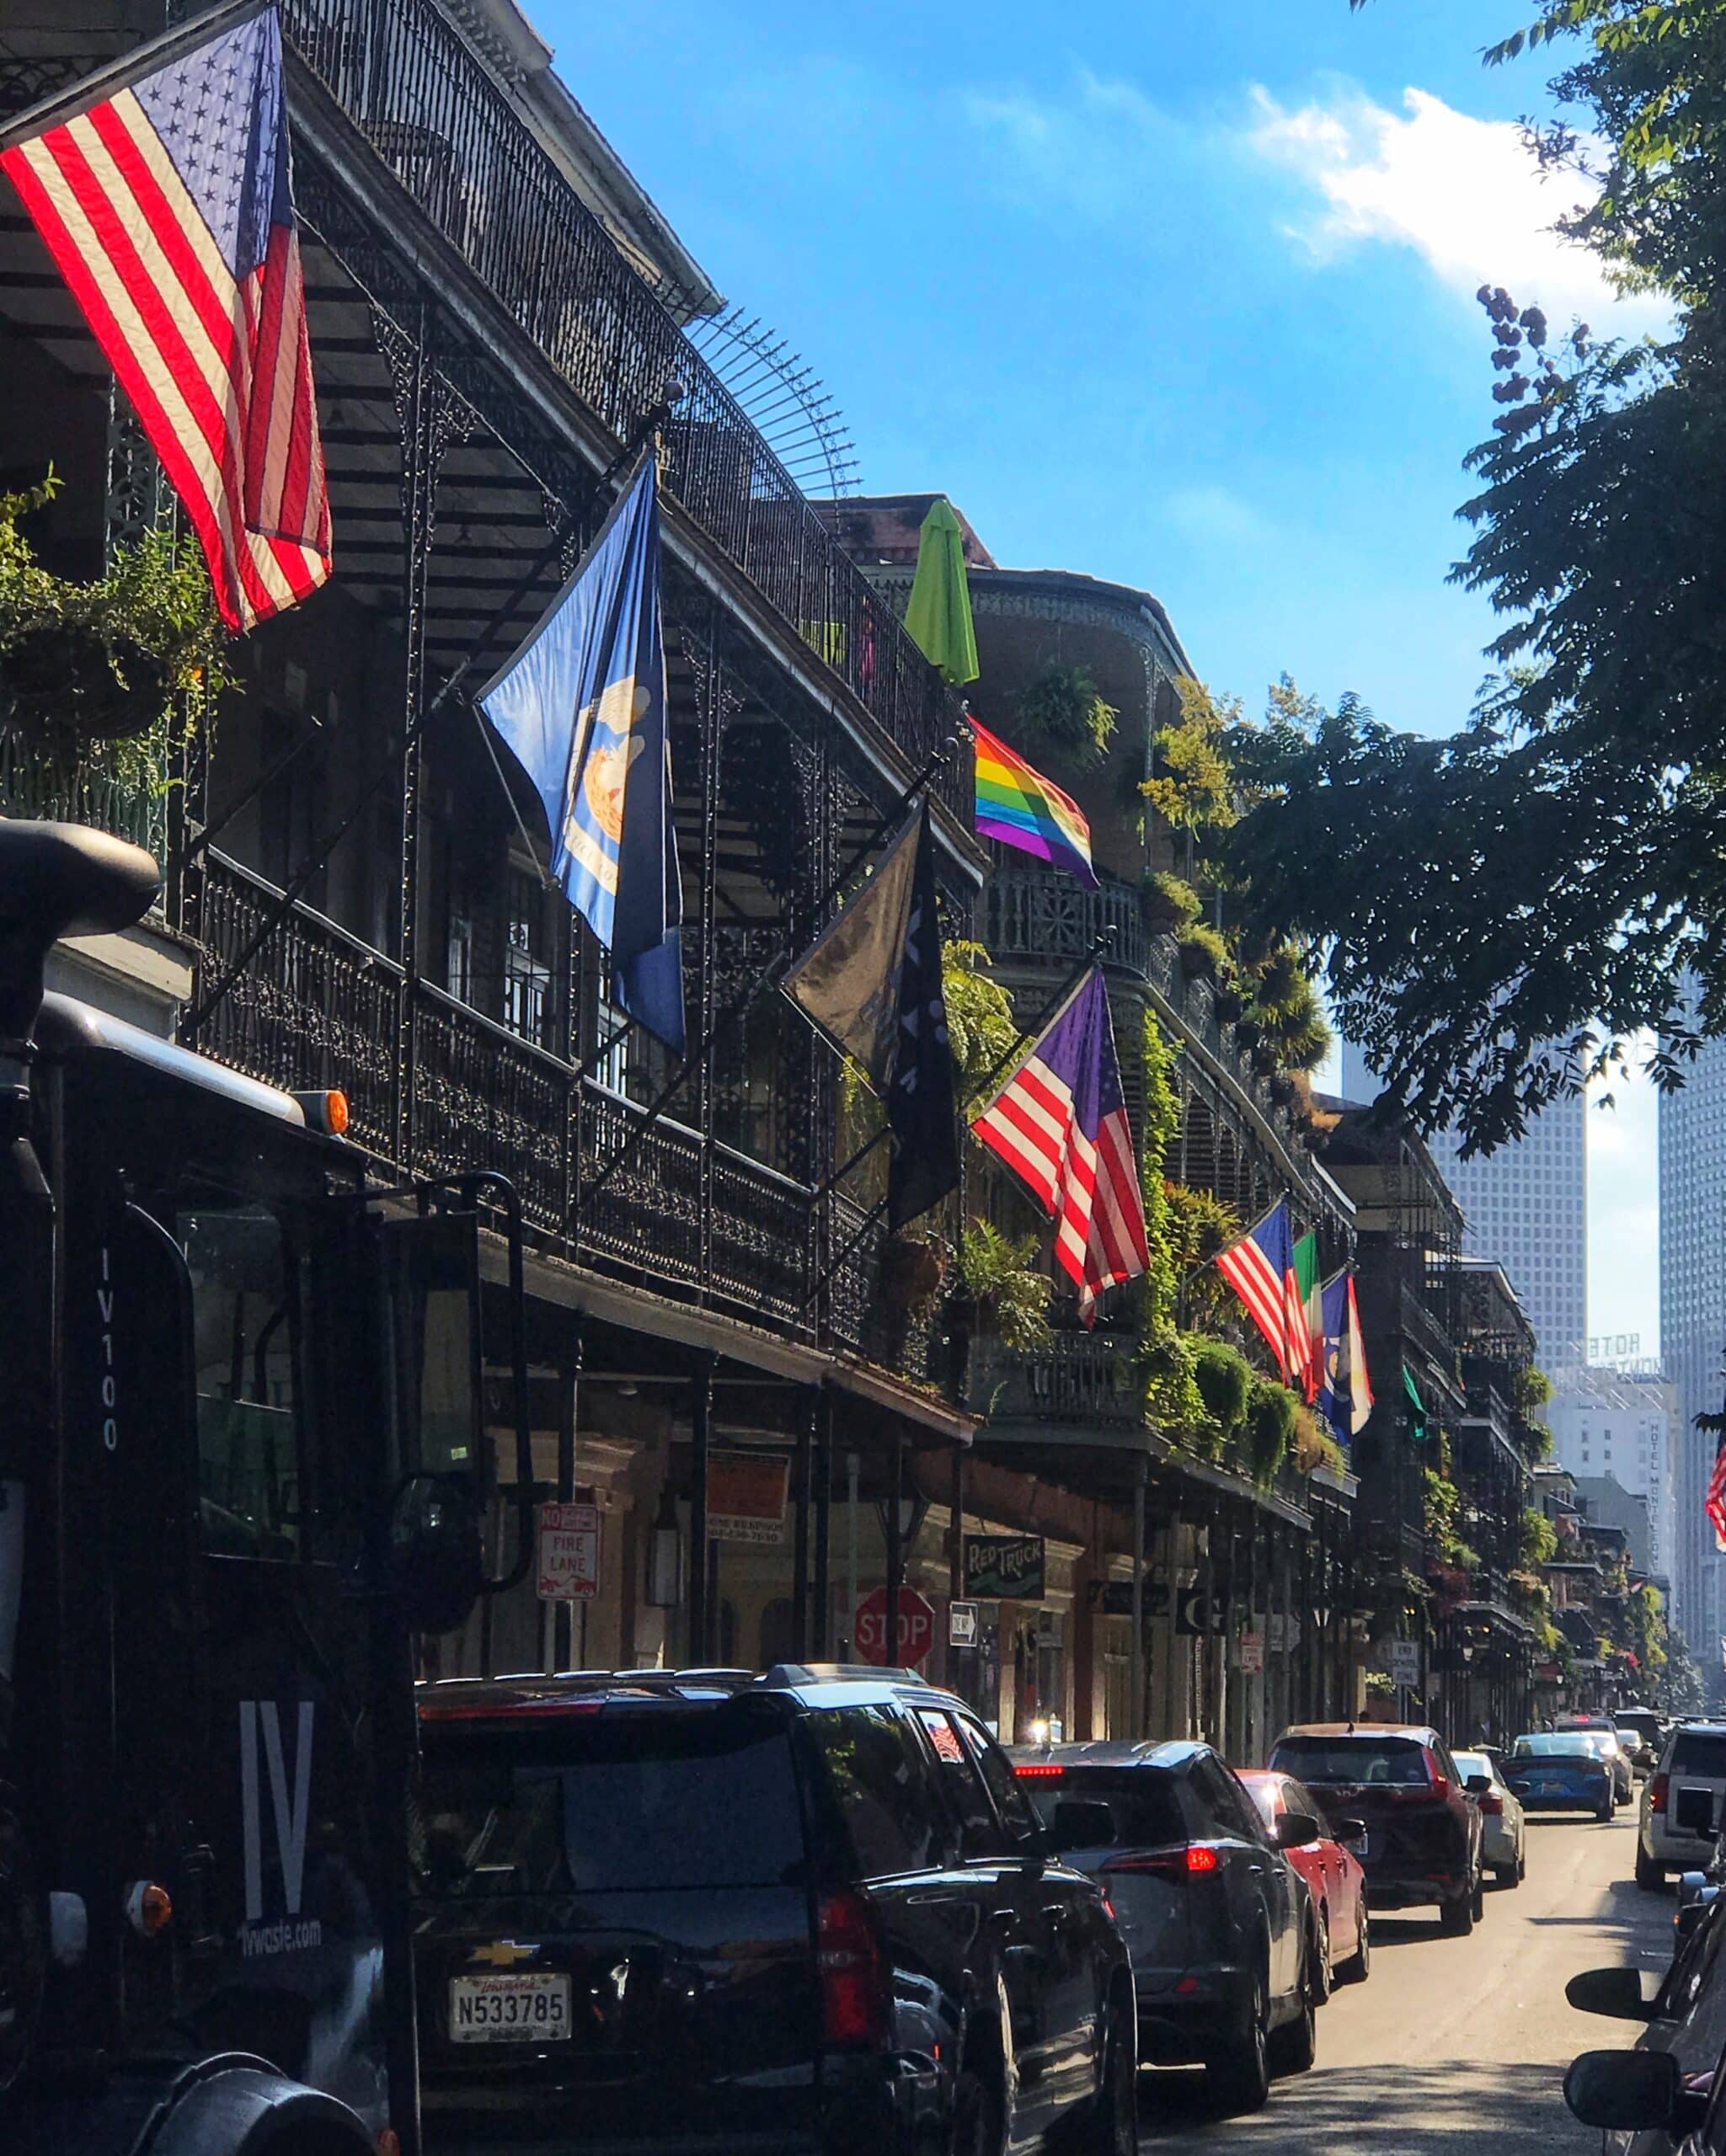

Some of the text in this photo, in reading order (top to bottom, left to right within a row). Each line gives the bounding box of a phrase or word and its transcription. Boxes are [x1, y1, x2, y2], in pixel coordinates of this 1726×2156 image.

[1650, 1424, 1659, 1470] HOTEL
[542, 1508, 561, 1527] NO
[553, 1536, 584, 1551] FIRE
[550, 1556, 586, 1572] LANE
[858, 1613, 927, 1646] STOP
[239, 1700, 315, 1920] IV
[459, 1994, 564, 2025] N533785
